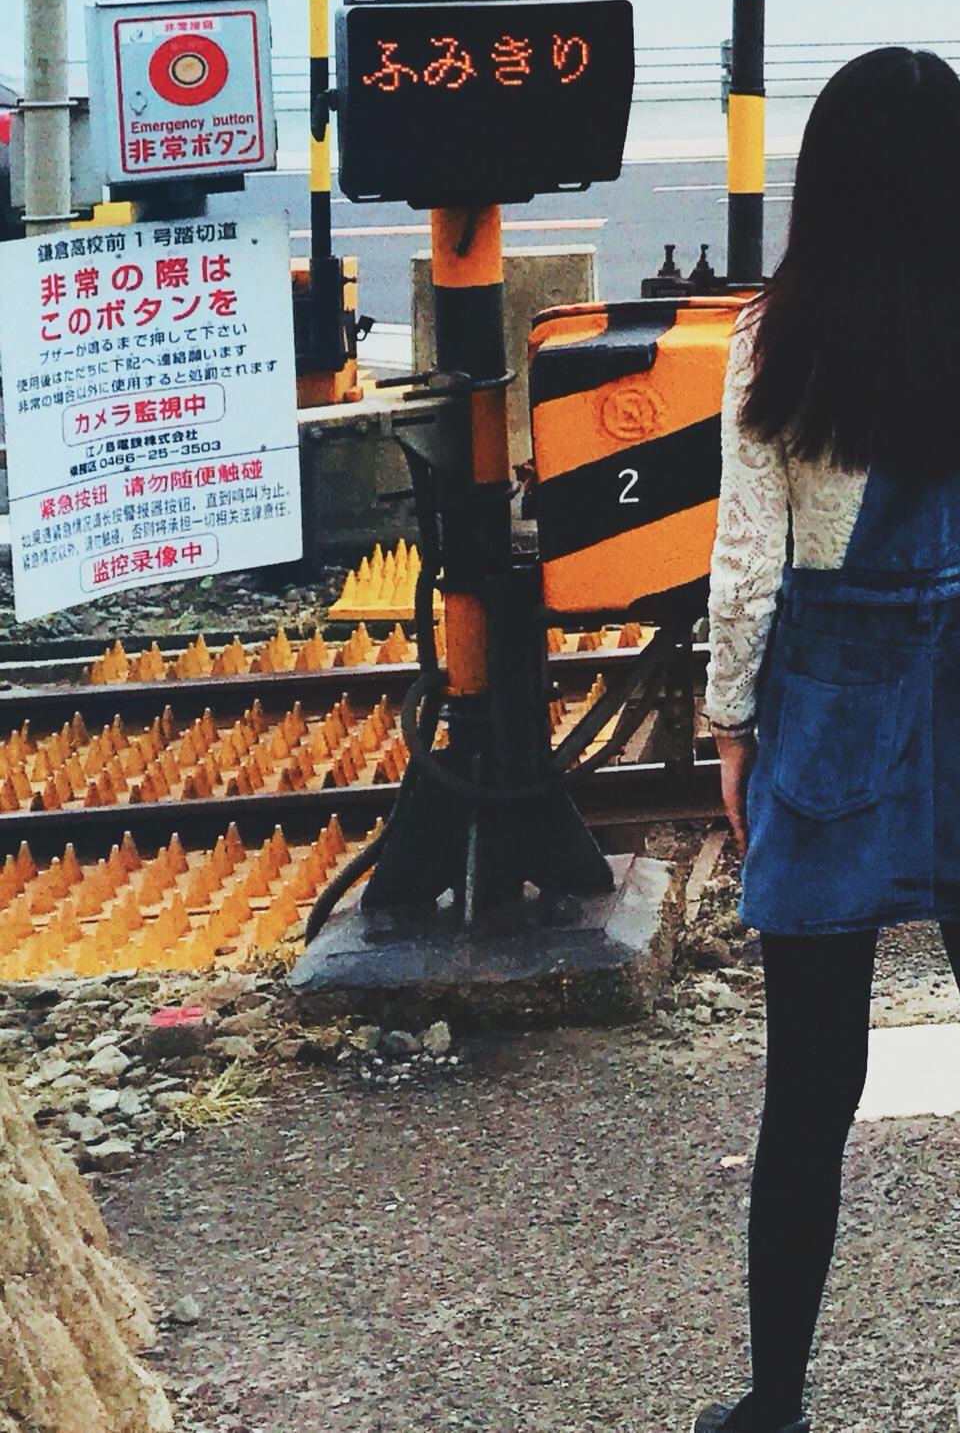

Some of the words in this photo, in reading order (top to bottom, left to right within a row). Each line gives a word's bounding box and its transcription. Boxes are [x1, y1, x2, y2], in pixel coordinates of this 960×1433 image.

[362, 34, 590, 91] ふみきり
[131, 118, 205, 134] Emergency
[212, 114, 255, 127] button
[128, 129, 257, 164] 非常ボタン
[41, 254, 231, 306] 非常の際は
[41, 288, 238, 341] このボタンを
[75, 394, 206, 435] カメラ監視中
[40, 484, 108, 520] 紧急按钮
[124, 458, 263, 497] 请勿随便触碰
[618, 468, 639, 503] 2
[93, 541, 202, 584] 监控录像中
